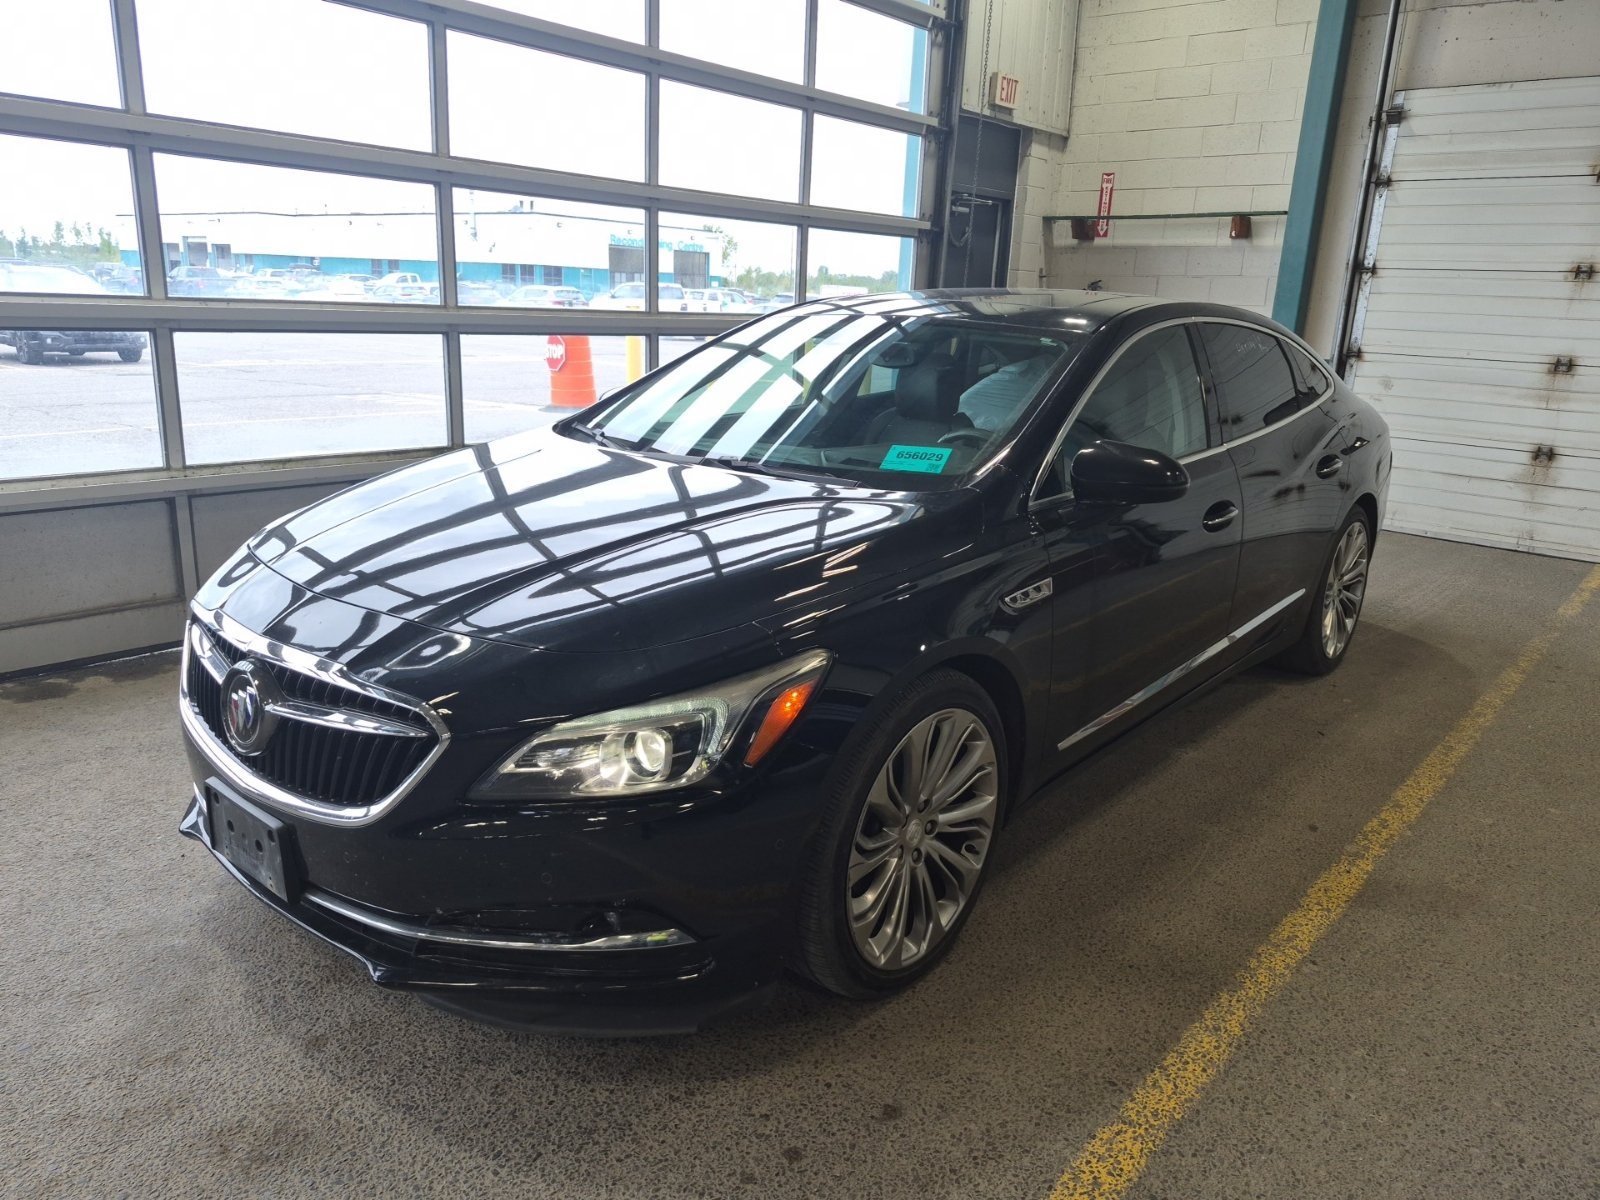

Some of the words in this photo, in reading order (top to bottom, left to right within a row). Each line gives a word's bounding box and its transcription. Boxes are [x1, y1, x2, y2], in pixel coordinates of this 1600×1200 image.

[1000, 76, 1019, 104] EXIT
[610, 234, 673, 251] Reconding
[678, 240, 704, 252] Centre
[545, 344, 563, 359] STOP
[896, 450, 944, 462] 656029
